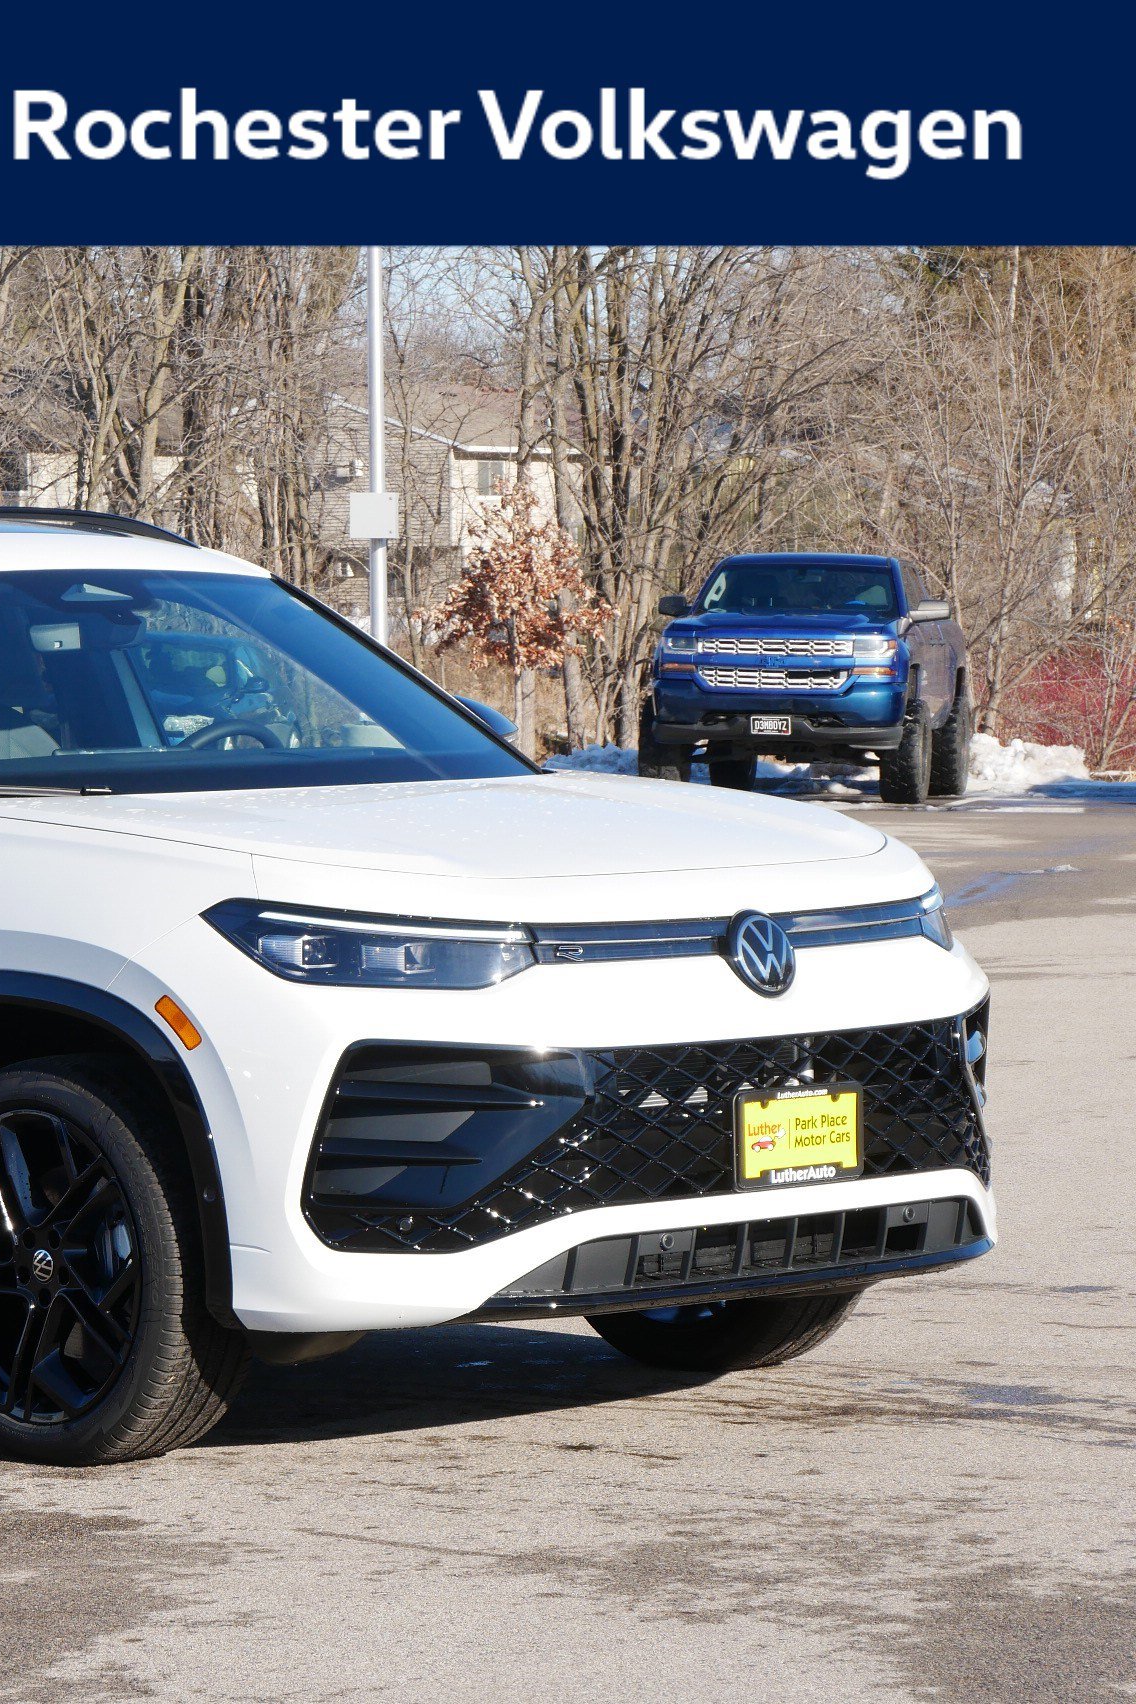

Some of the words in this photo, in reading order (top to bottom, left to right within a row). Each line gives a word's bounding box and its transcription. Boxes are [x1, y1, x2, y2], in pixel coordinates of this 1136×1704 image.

[777, 1089, 828, 1099] LutherAuto.com
[747, 1123, 781, 1136] Luther
[795, 1116, 818, 1130] Park
[821, 1114, 848, 1127] Place
[794, 1134, 827, 1148] Motor
[829, 1130, 851, 1144] Cars
[771, 1166, 836, 1183] LutherAuto
